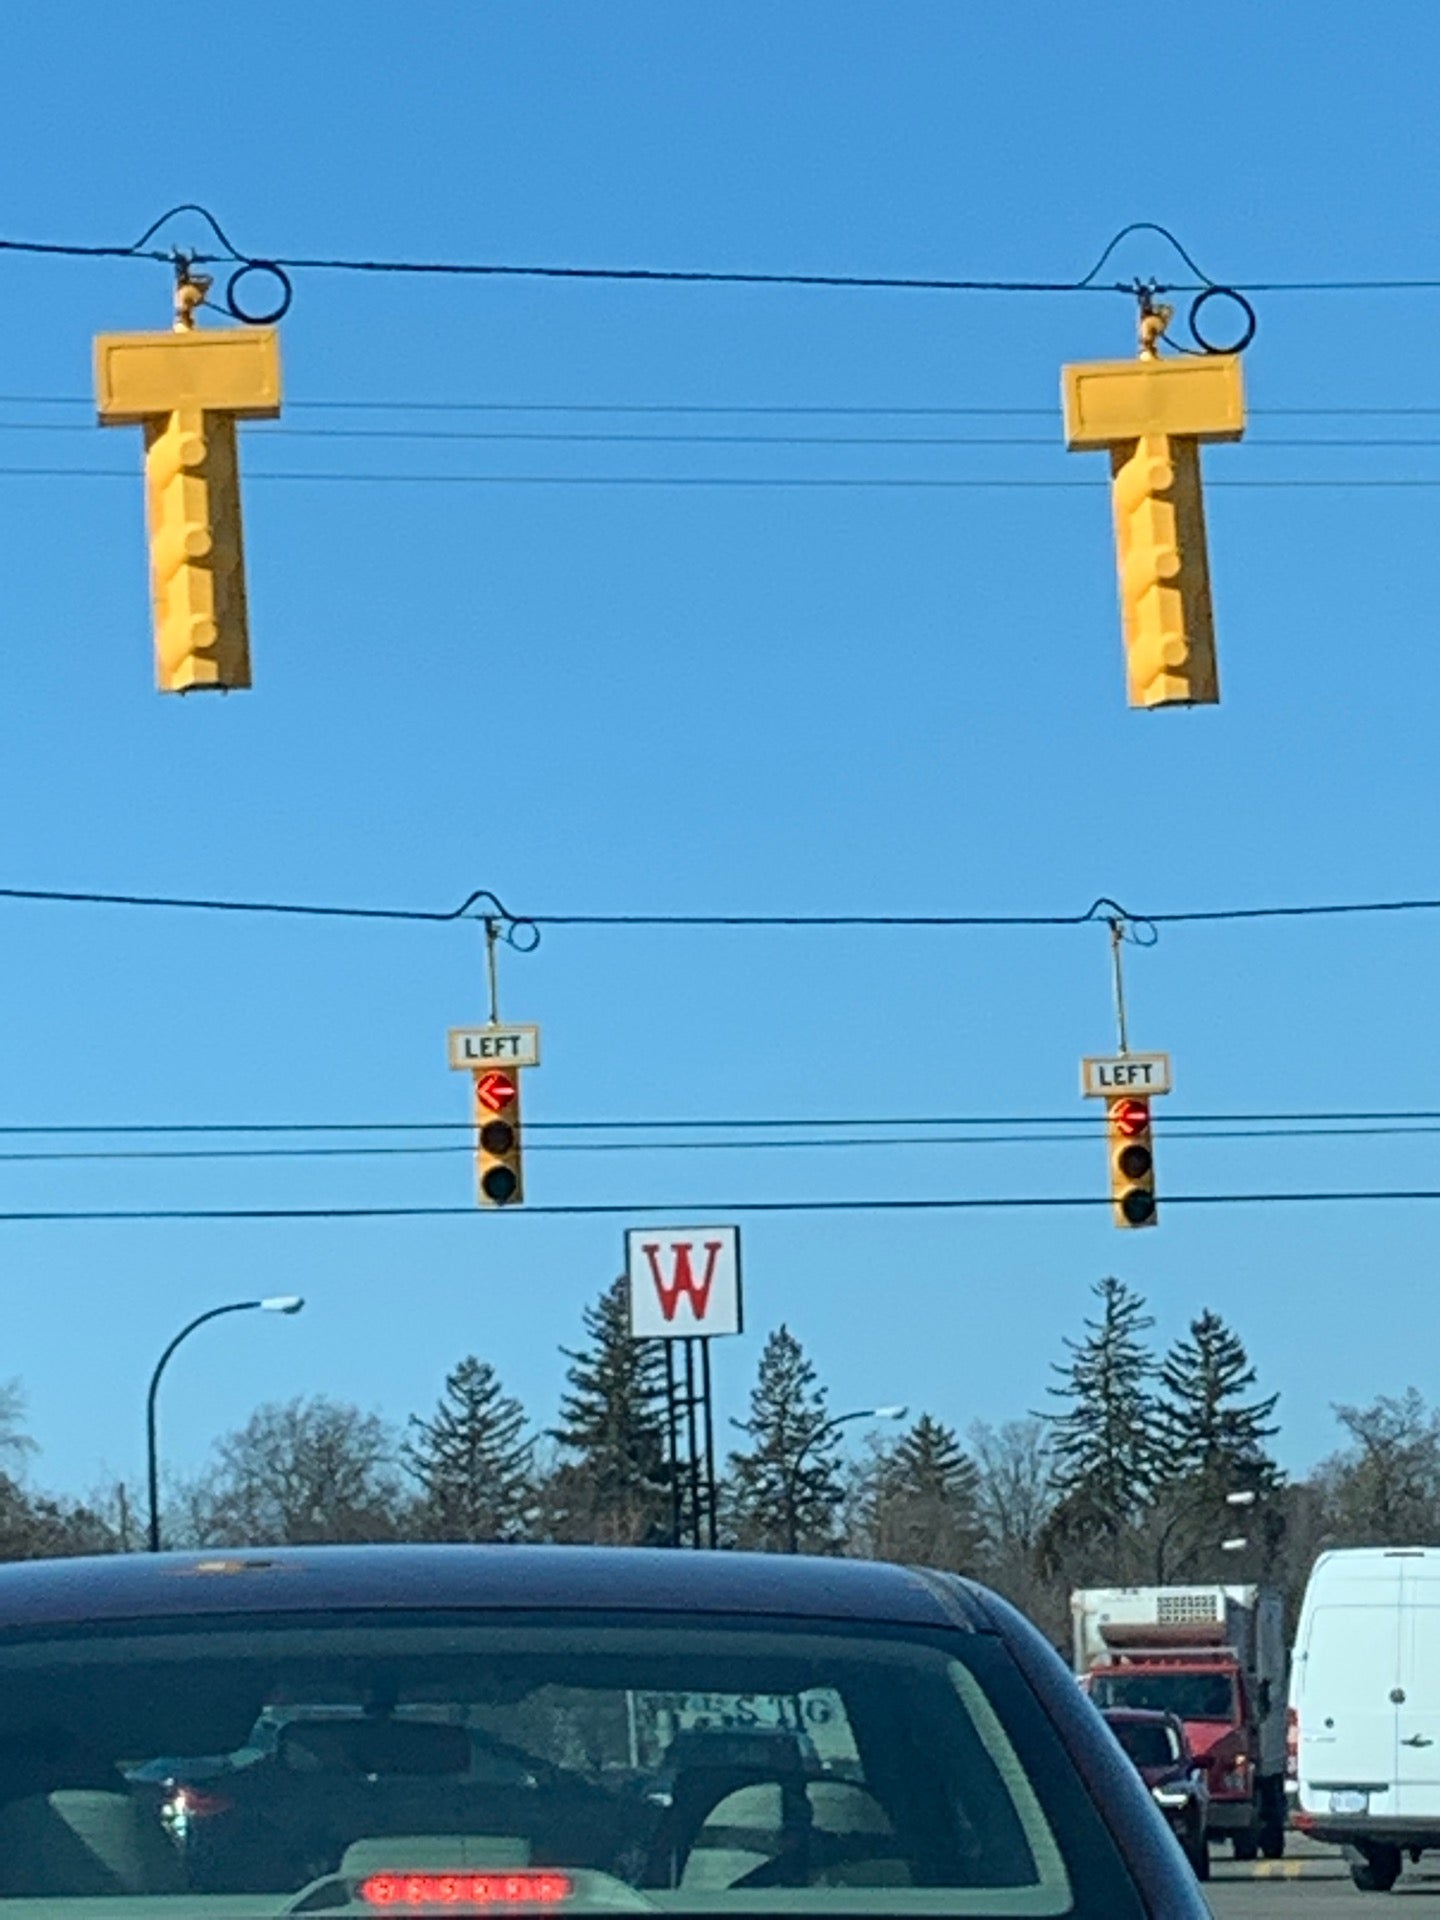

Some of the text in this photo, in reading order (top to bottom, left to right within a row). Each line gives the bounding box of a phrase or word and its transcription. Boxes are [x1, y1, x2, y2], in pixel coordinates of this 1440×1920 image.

[465, 1035, 520, 1058] LEFT
[1099, 1063, 1152, 1086] LEFT
[641, 1241, 722, 1322] W
